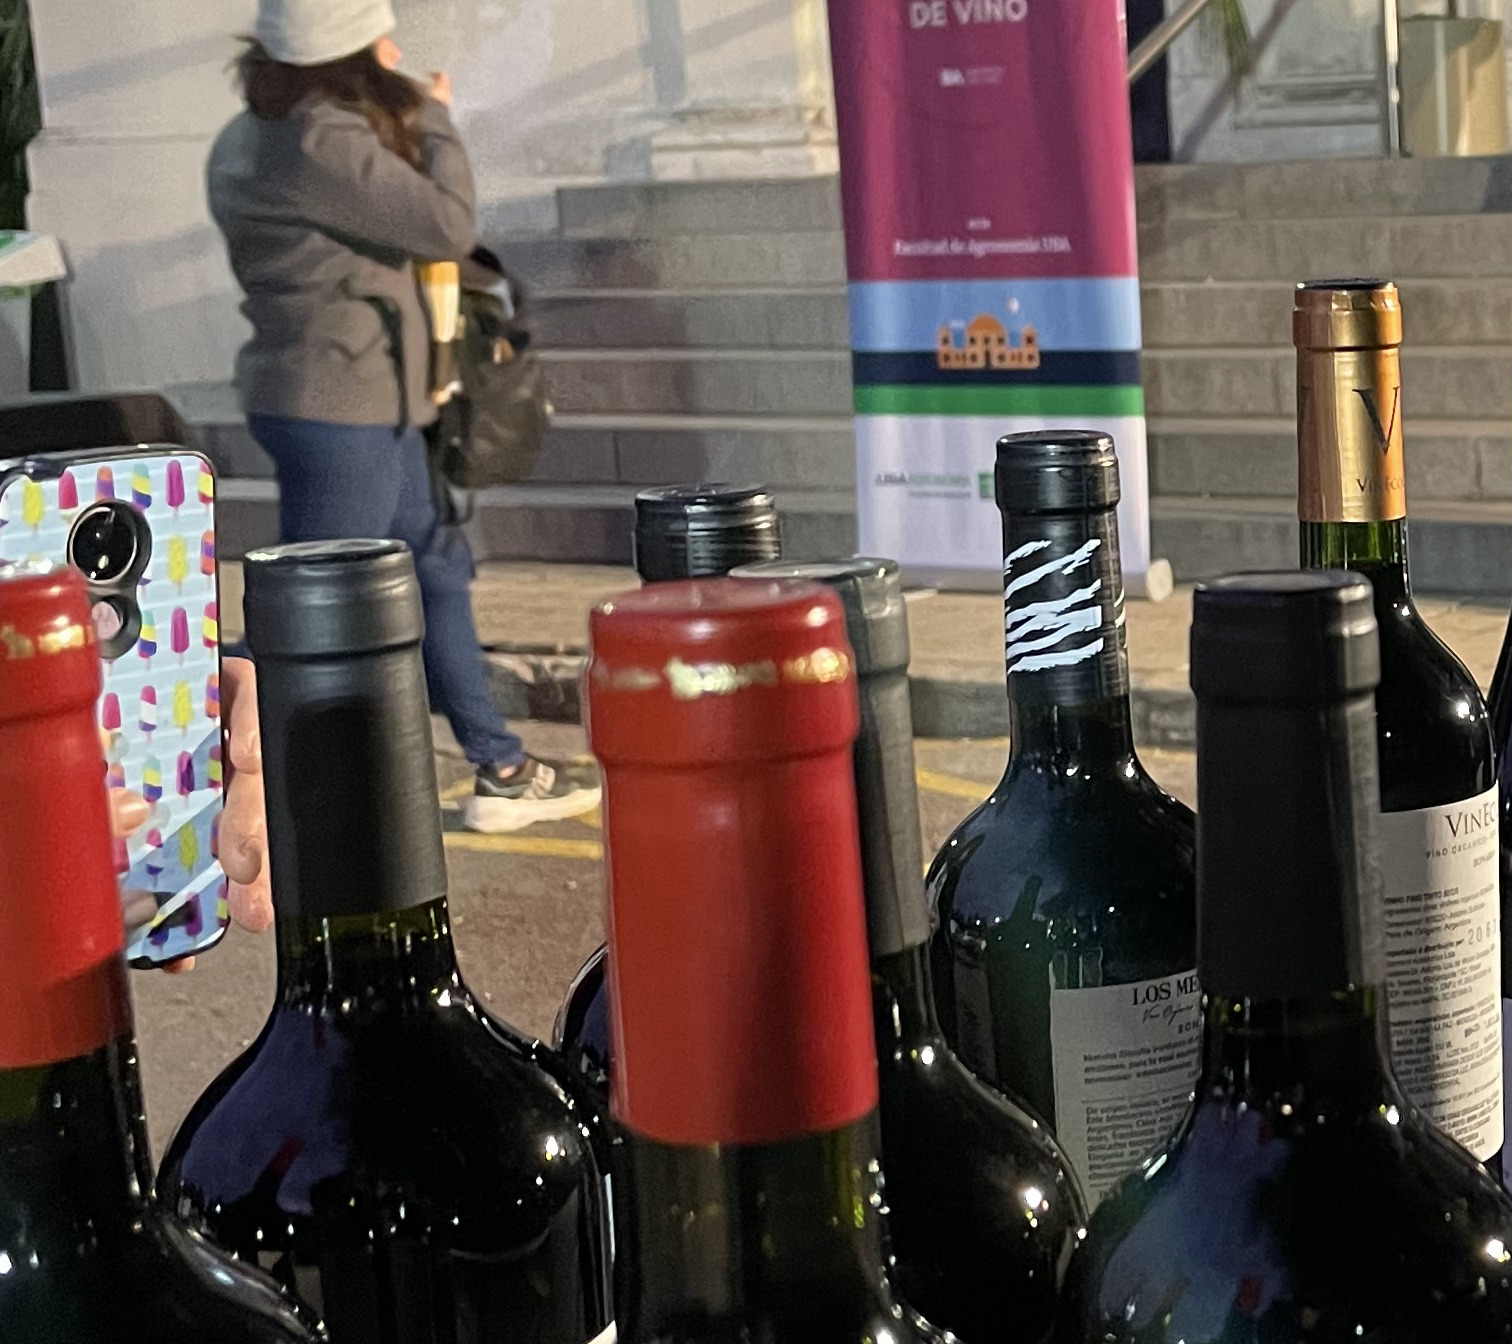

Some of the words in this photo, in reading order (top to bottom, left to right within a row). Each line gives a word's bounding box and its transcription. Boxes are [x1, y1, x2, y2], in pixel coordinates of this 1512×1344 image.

[908, 1, 948, 29] DE
[1352, 386, 1400, 455] V
[1133, 982, 1171, 1006] LOS
